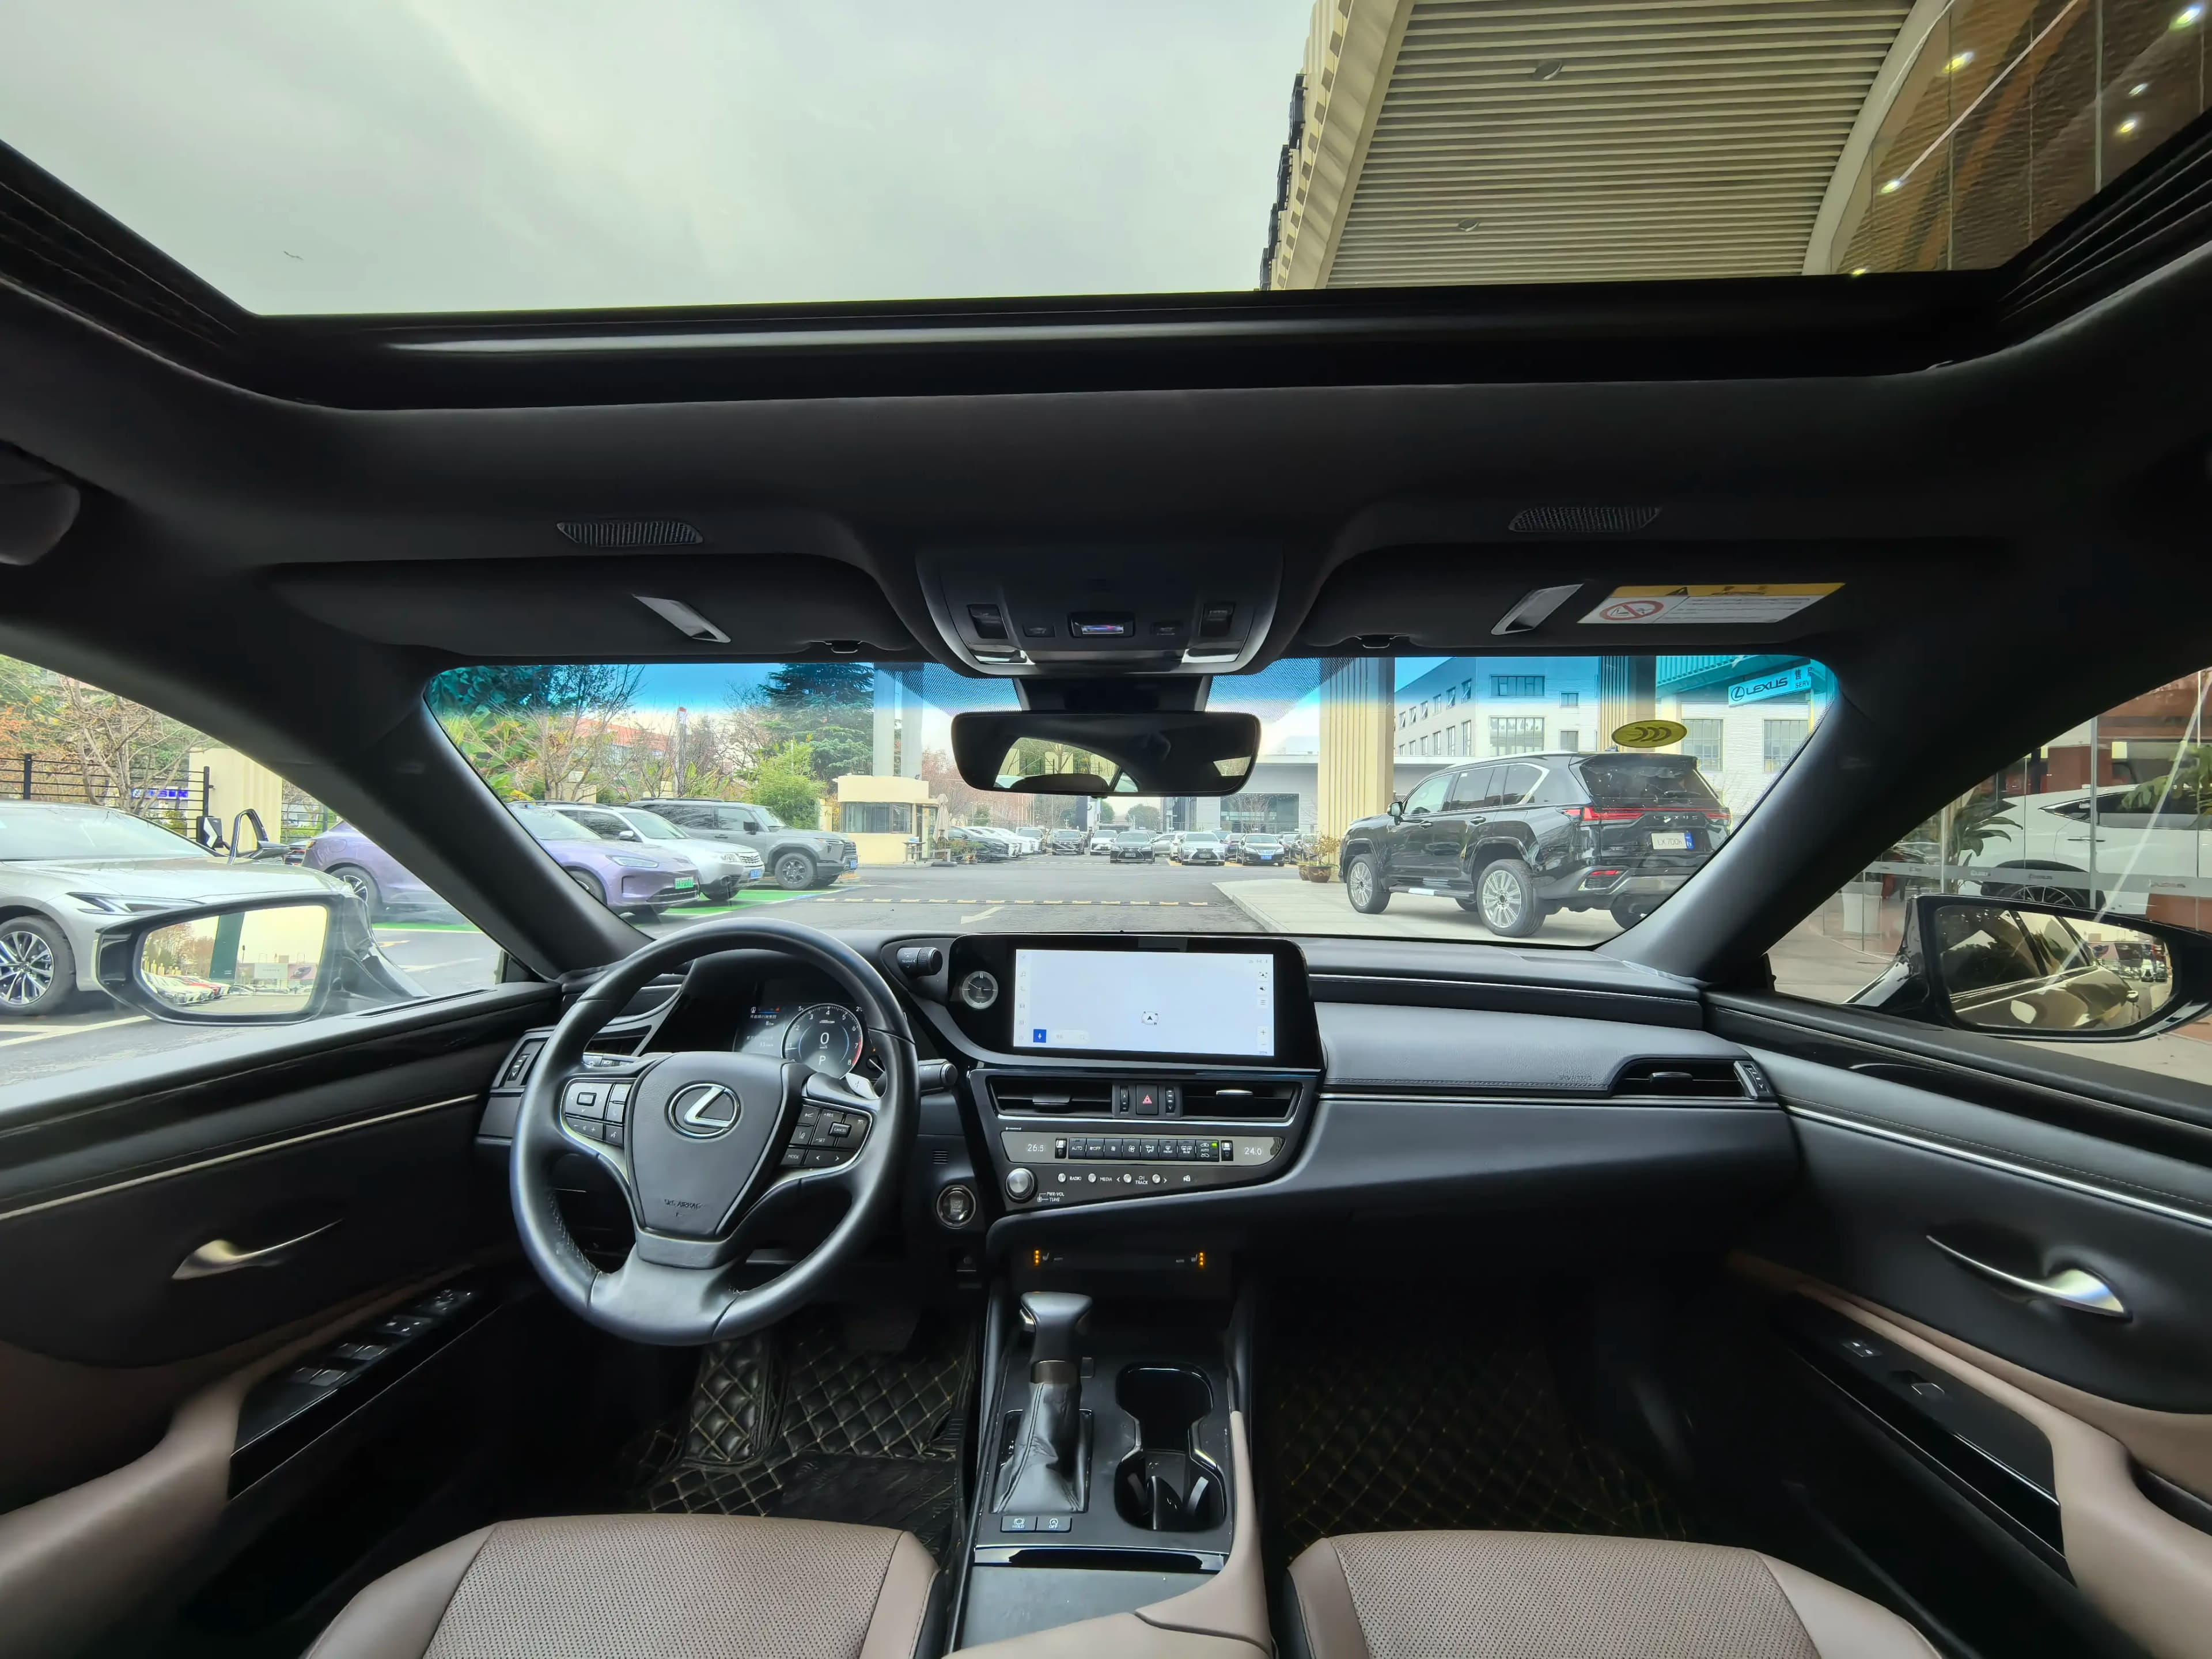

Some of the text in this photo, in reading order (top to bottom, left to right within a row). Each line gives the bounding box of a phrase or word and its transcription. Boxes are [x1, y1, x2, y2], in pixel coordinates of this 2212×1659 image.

[1747, 677, 1788, 695] LEXUS
[820, 1032, 830, 1044] 0
[819, 1055, 826, 1066] P
[1027, 1144, 1044, 1152] 26.5
[1244, 1147, 1262, 1156] 24.0
